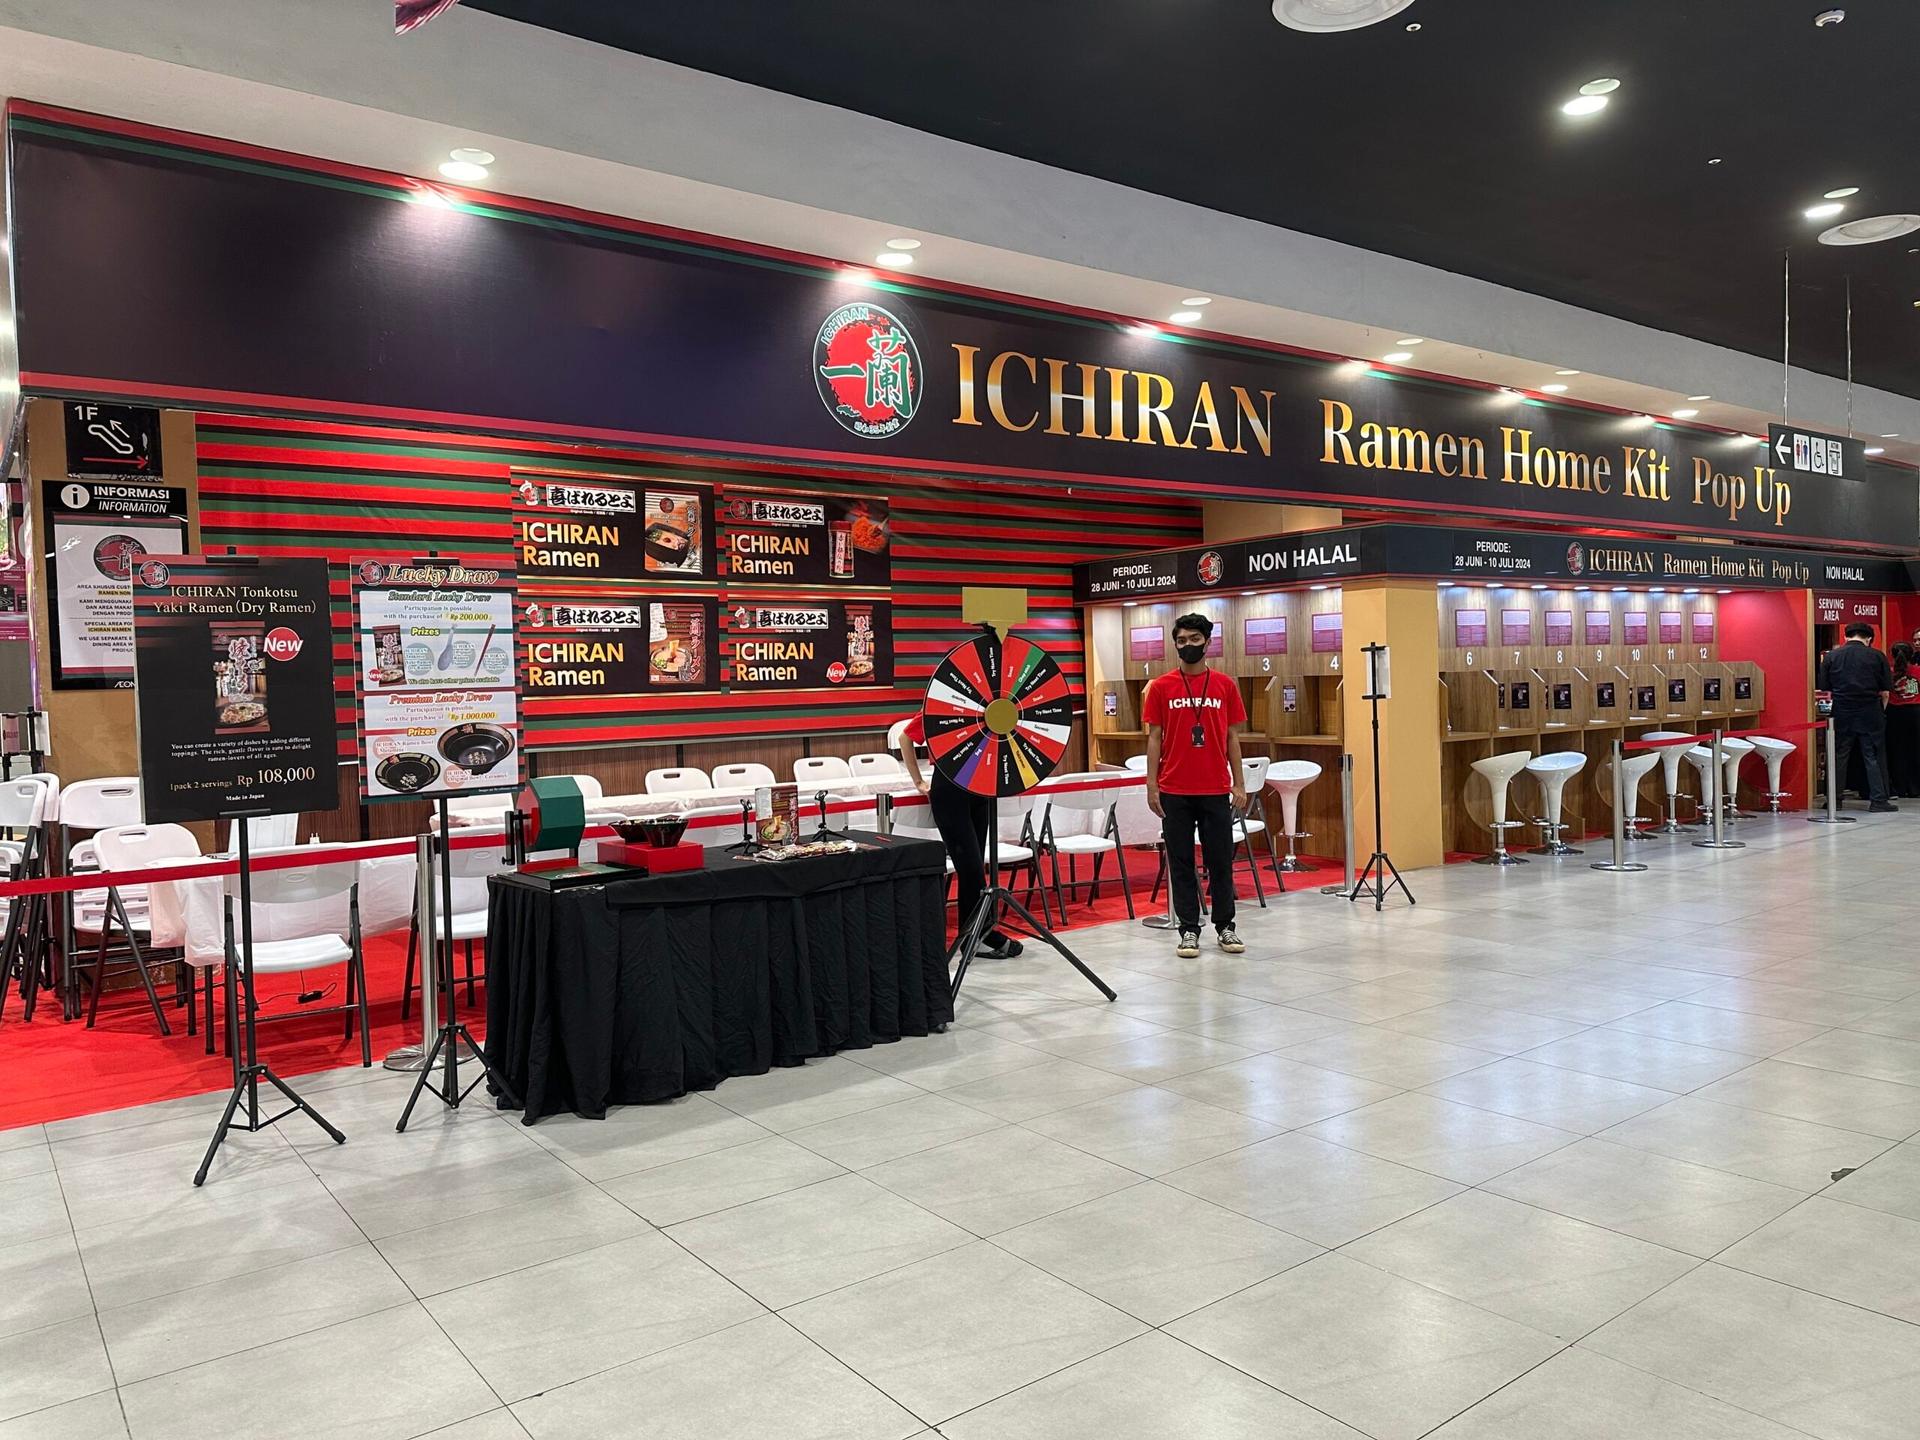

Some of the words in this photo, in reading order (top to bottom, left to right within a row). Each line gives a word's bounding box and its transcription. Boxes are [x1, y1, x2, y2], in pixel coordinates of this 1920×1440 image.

[820, 307, 869, 346] ICHIRAN
[819, 326, 912, 418] 一蘭
[74, 405, 98, 421] 1F
[951, 343, 1277, 457] ICHIRAN
[1319, 398, 1488, 480] Ramen
[1500, 426, 1611, 494] Home
[1622, 446, 1671, 502] Kit
[1692, 456, 1746, 521] Pop
[1753, 466, 1792, 526] Up
[93, 486, 170, 499] INFORMASI
[98, 501, 167, 514] INFORMATION
[522, 522, 619, 546] ICHIRAN
[731, 534, 809, 555] ICHIRAN
[1476, 541, 1511, 553] PERIODE:
[524, 545, 600, 568] Ramen
[1249, 552, 1287, 573] NON
[1293, 544, 1357, 568] HALAL
[1455, 555, 1464, 566] 28
[1465, 556, 1483, 567] JUNI
[1488, 557, 1497, 568] 10
[1498, 557, 1514, 568] JULI
[1515, 558, 1531, 569] 2024
[732, 555, 794, 575] Ramen
[1112, 564, 1152, 577] PERIODE:
[1589, 549, 1654, 573] ICHIRAN
[1663, 553, 1707, 575] Ramen
[1711, 555, 1745, 577] Home
[1748, 558, 1765, 578] Kit
[1772, 559, 1792, 583] Pop
[1794, 561, 1810, 584] Up
[387, 564, 447, 587] Lucky
[448, 567, 499, 584] Draw
[1825, 566, 1841, 579] NON
[1841, 567, 1865, 581] HALAL
[1091, 583, 1101, 592] 28
[1101, 581, 1120, 592] JUNI
[1126, 579, 1136, 590] 10
[1136, 577, 1156, 590] JULI
[1156, 575, 1177, 588] 2024
[170, 586, 236, 598] ICHIRAN
[241, 586, 298, 598] Tonkotsu
[154, 602, 183, 613] Yaki
[188, 602, 233, 613] Ramen
[235, 600, 265, 616] (Dry
[270, 600, 317, 615] Ramen)
[1818, 598, 1844, 610] SERVING
[1854, 604, 1878, 616] CASHIER
[1823, 610, 1840, 622] AREA
[411, 626, 440, 636] Prizes
[263, 637, 304, 652] New
[735, 642, 814, 661] ICHIRAN
[528, 642, 624, 663] ICHIRAN
[1466, 652, 1473, 666] 6
[1514, 651, 1521, 665] 7
[1556, 650, 1563, 664] 8
[1596, 650, 1602, 662] 9
[1632, 649, 1640, 661] 10
[1668, 648, 1675, 660] 11
[1700, 648, 1707, 659] 12
[1143, 662, 1149, 675] 1
[1262, 657, 1271, 671] 3
[1330, 655, 1340, 670] 4
[529, 666, 605, 686] Ramen
[736, 663, 797, 681] Ramen
[826, 667, 848, 679] New
[407, 727, 437, 736] Prizes
[194, 781, 200, 789] 2
[200, 780, 233, 790] servings
[237, 775, 253, 787] Rp
[257, 766, 315, 785] 108,000
